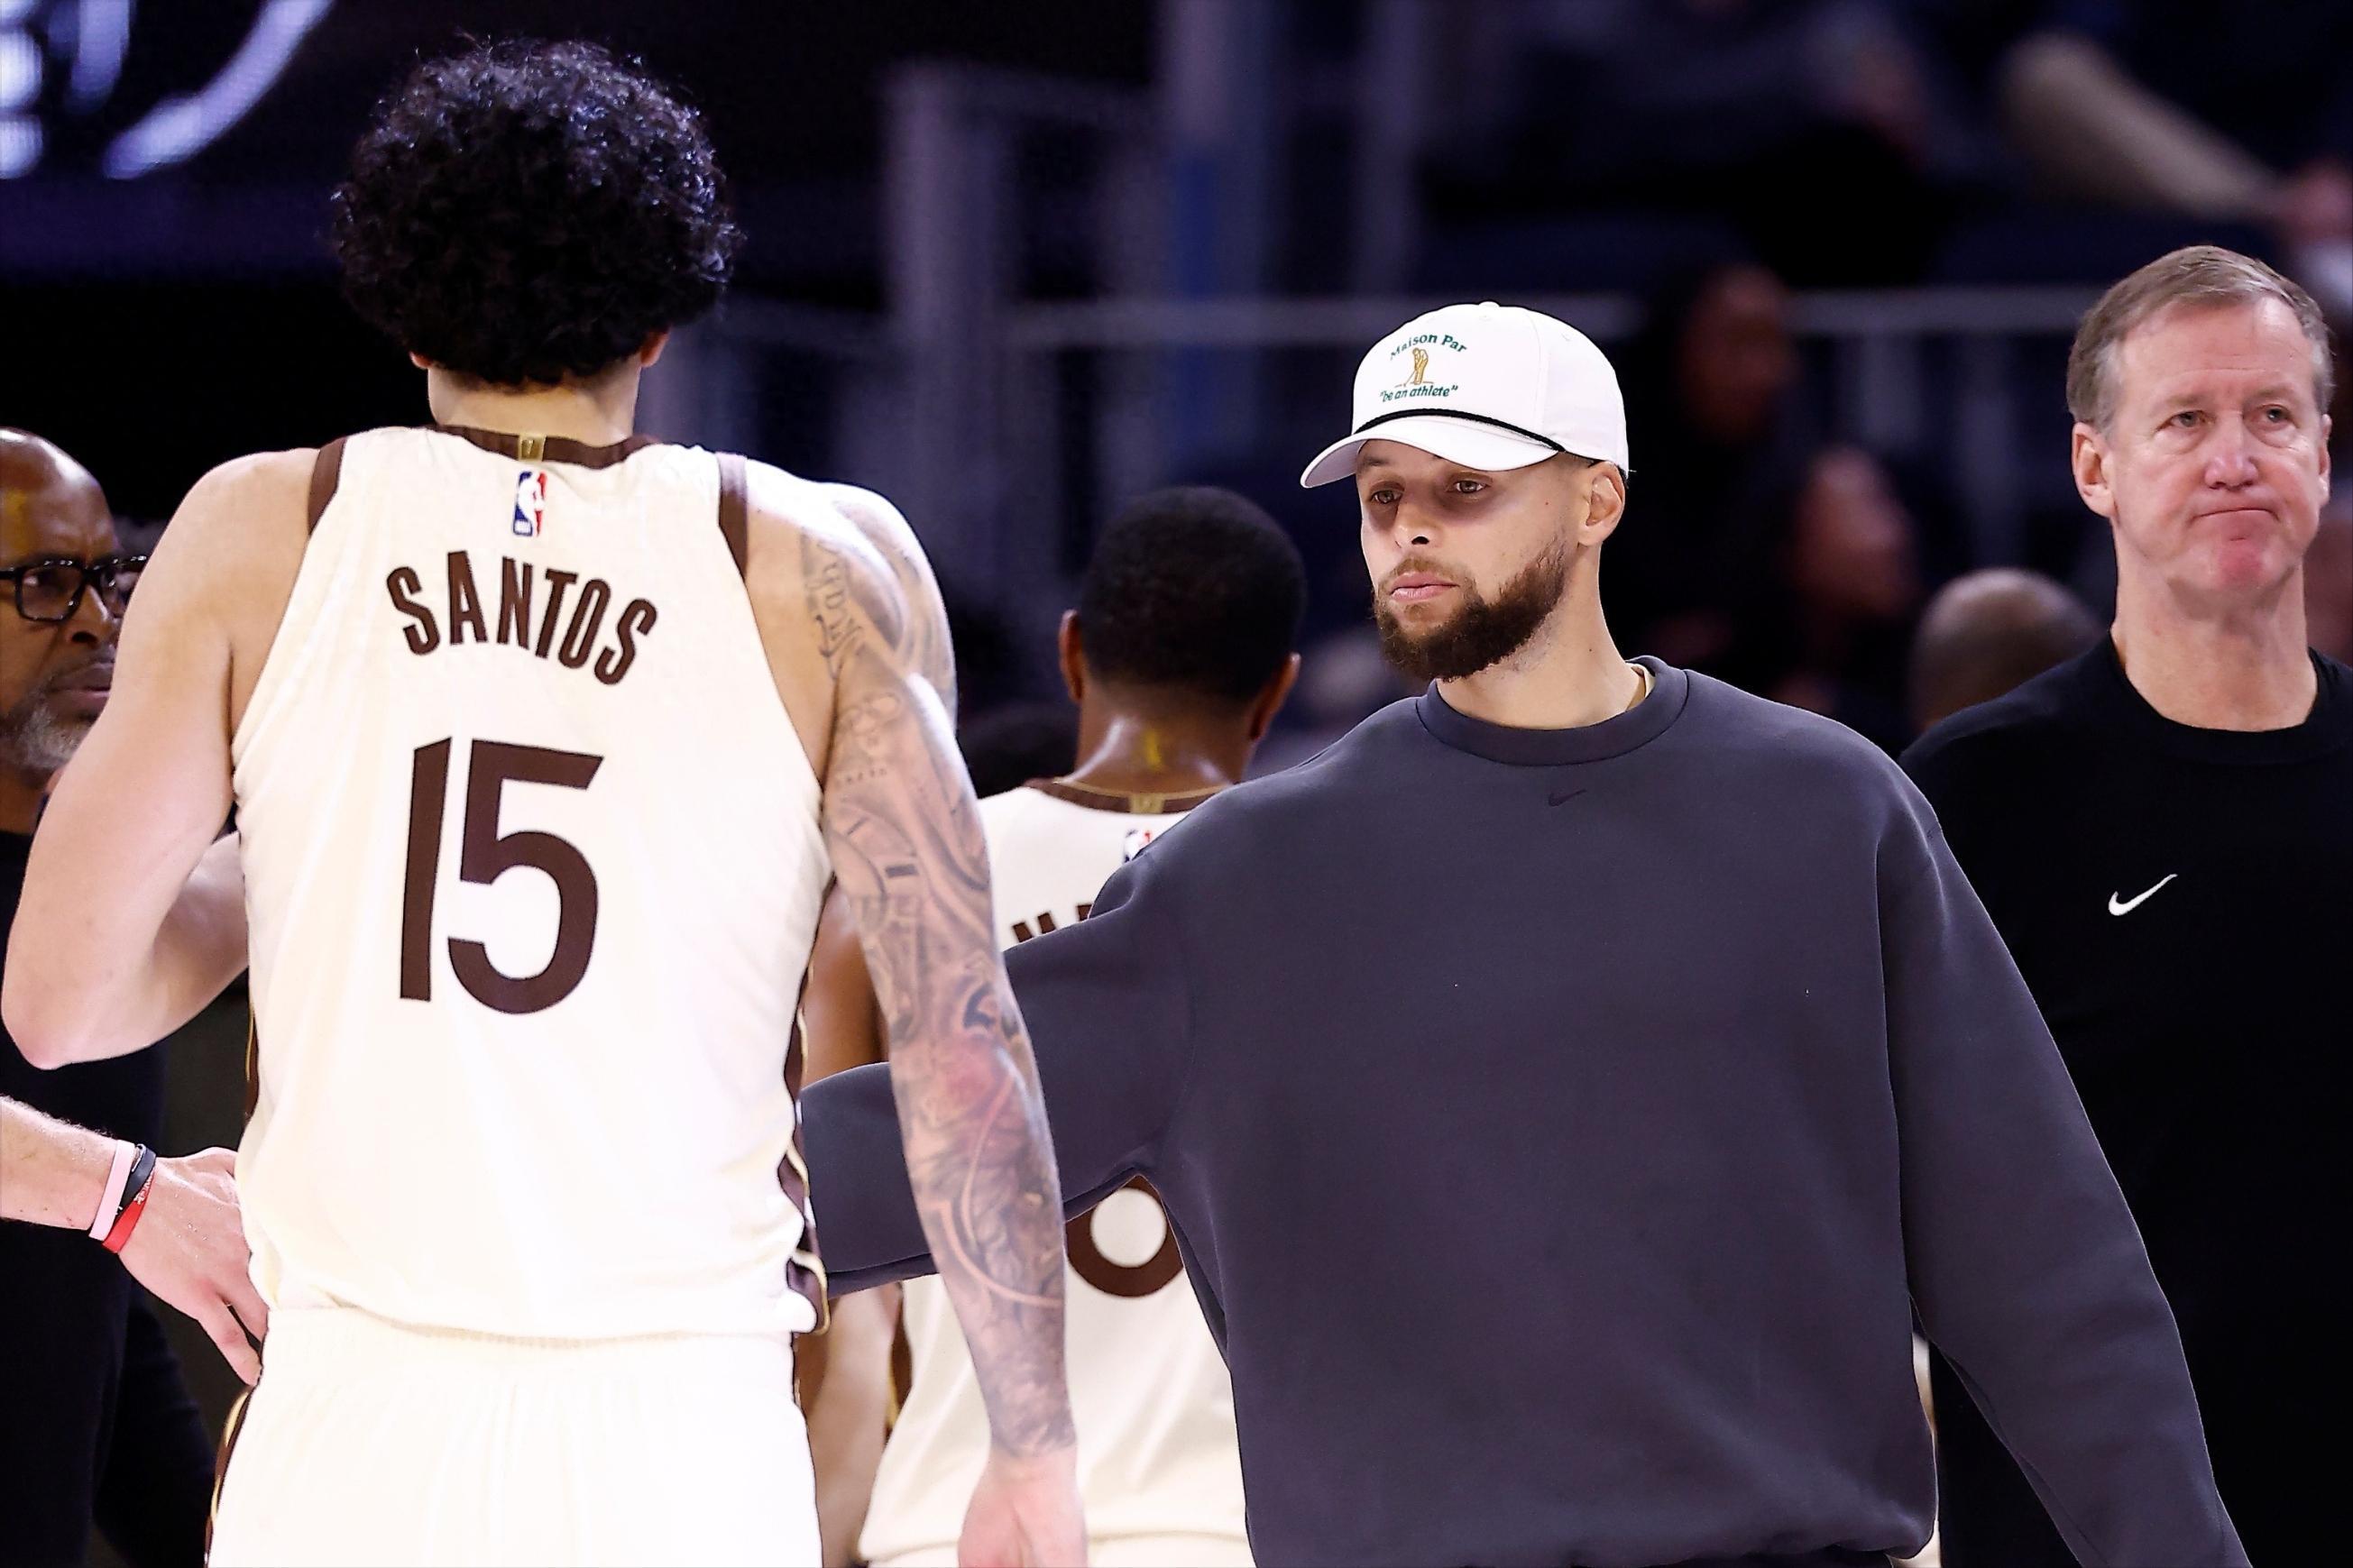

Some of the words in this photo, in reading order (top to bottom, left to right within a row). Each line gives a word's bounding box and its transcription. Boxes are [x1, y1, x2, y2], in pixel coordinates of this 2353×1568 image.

[1391, 335, 1438, 361] Maison
[1440, 335, 1467, 352] Par
[1394, 389, 1407, 400] an
[386, 550, 657, 685] SANTOS
[400, 737, 603, 1014] 15
